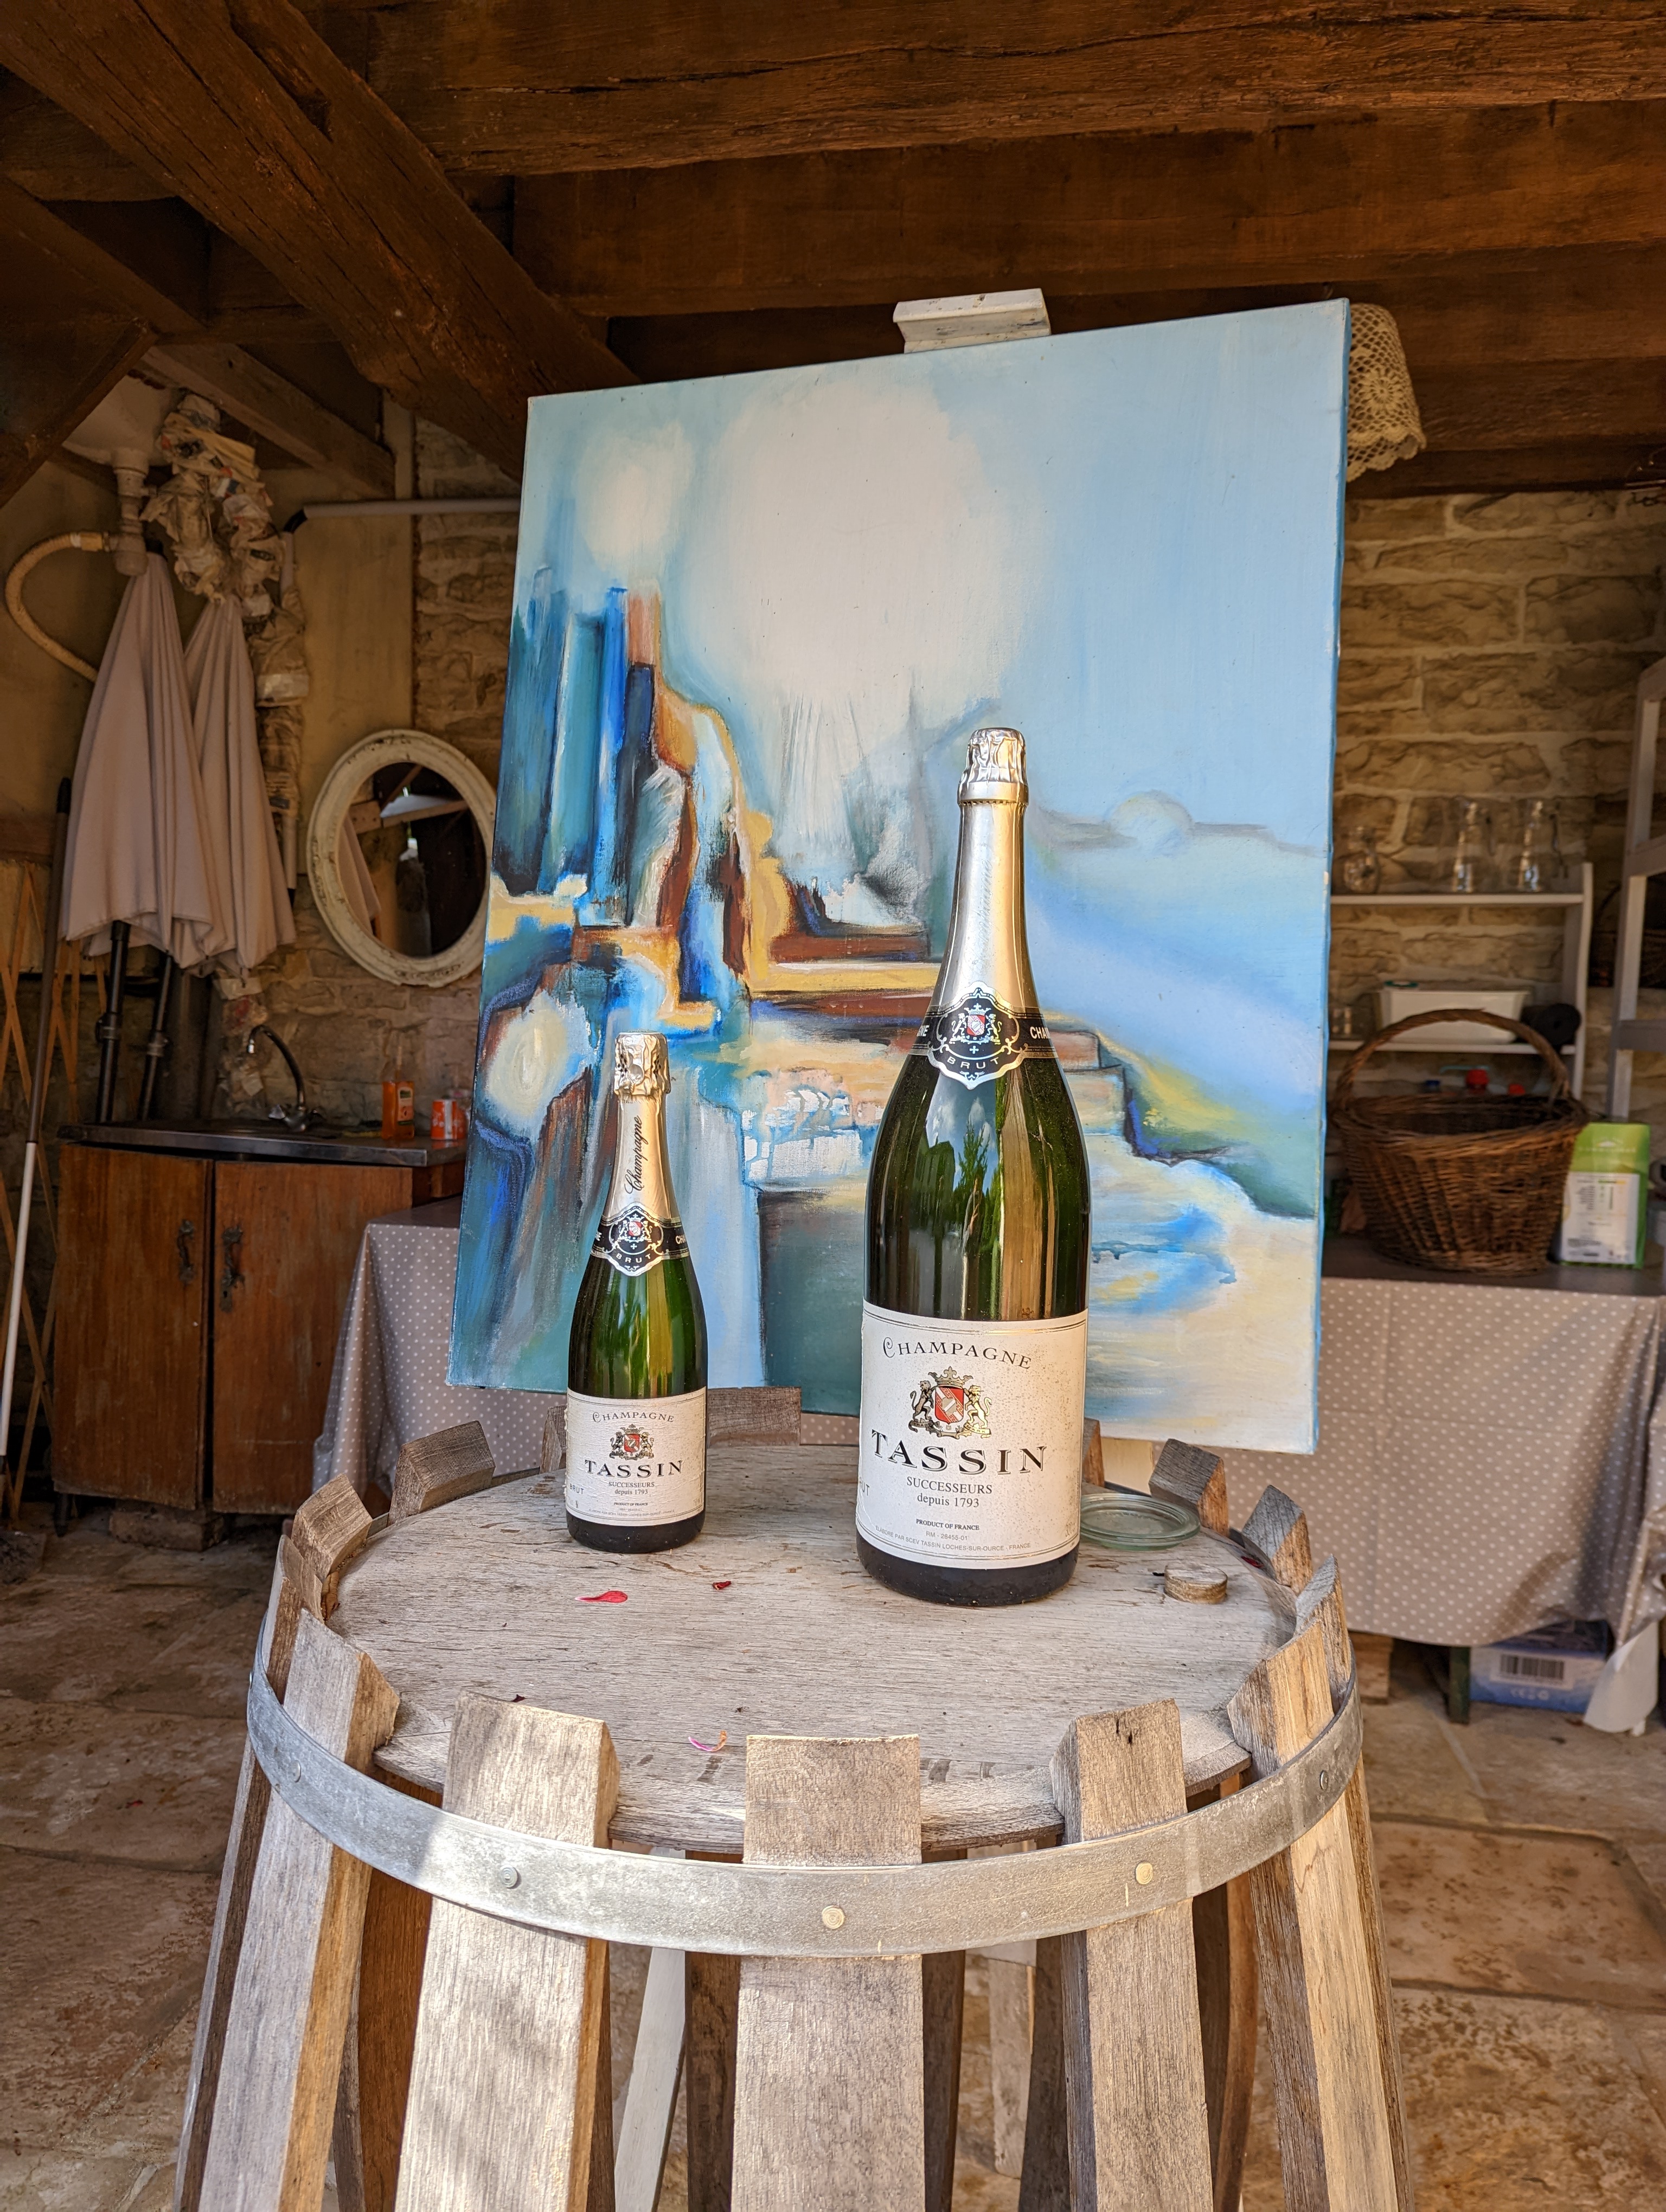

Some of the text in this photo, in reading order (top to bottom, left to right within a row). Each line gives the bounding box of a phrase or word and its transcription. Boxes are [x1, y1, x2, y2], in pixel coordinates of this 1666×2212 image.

[947, 1056, 999, 1069] BRUT
[624, 1115, 649, 1194] Champagne
[616, 1253, 651, 1263] BRUT
[883, 1336, 1031, 1369] CHAMPAGNE
[592, 1411, 675, 1423] CHAMPAGNE
[872, 1429, 1047, 1475] TASSIN
[584, 1459, 683, 1478] TASSIN
[569, 1483, 584, 1495] BRUT
[906, 1476, 992, 1494] SUCCESSEURS
[917, 1493, 979, 1508] depuis 1793
[915, 1518, 944, 1528] PRODUCT
[905, 1536, 920, 1545] SCEV
[921, 1540, 941, 1548] TASSIN
